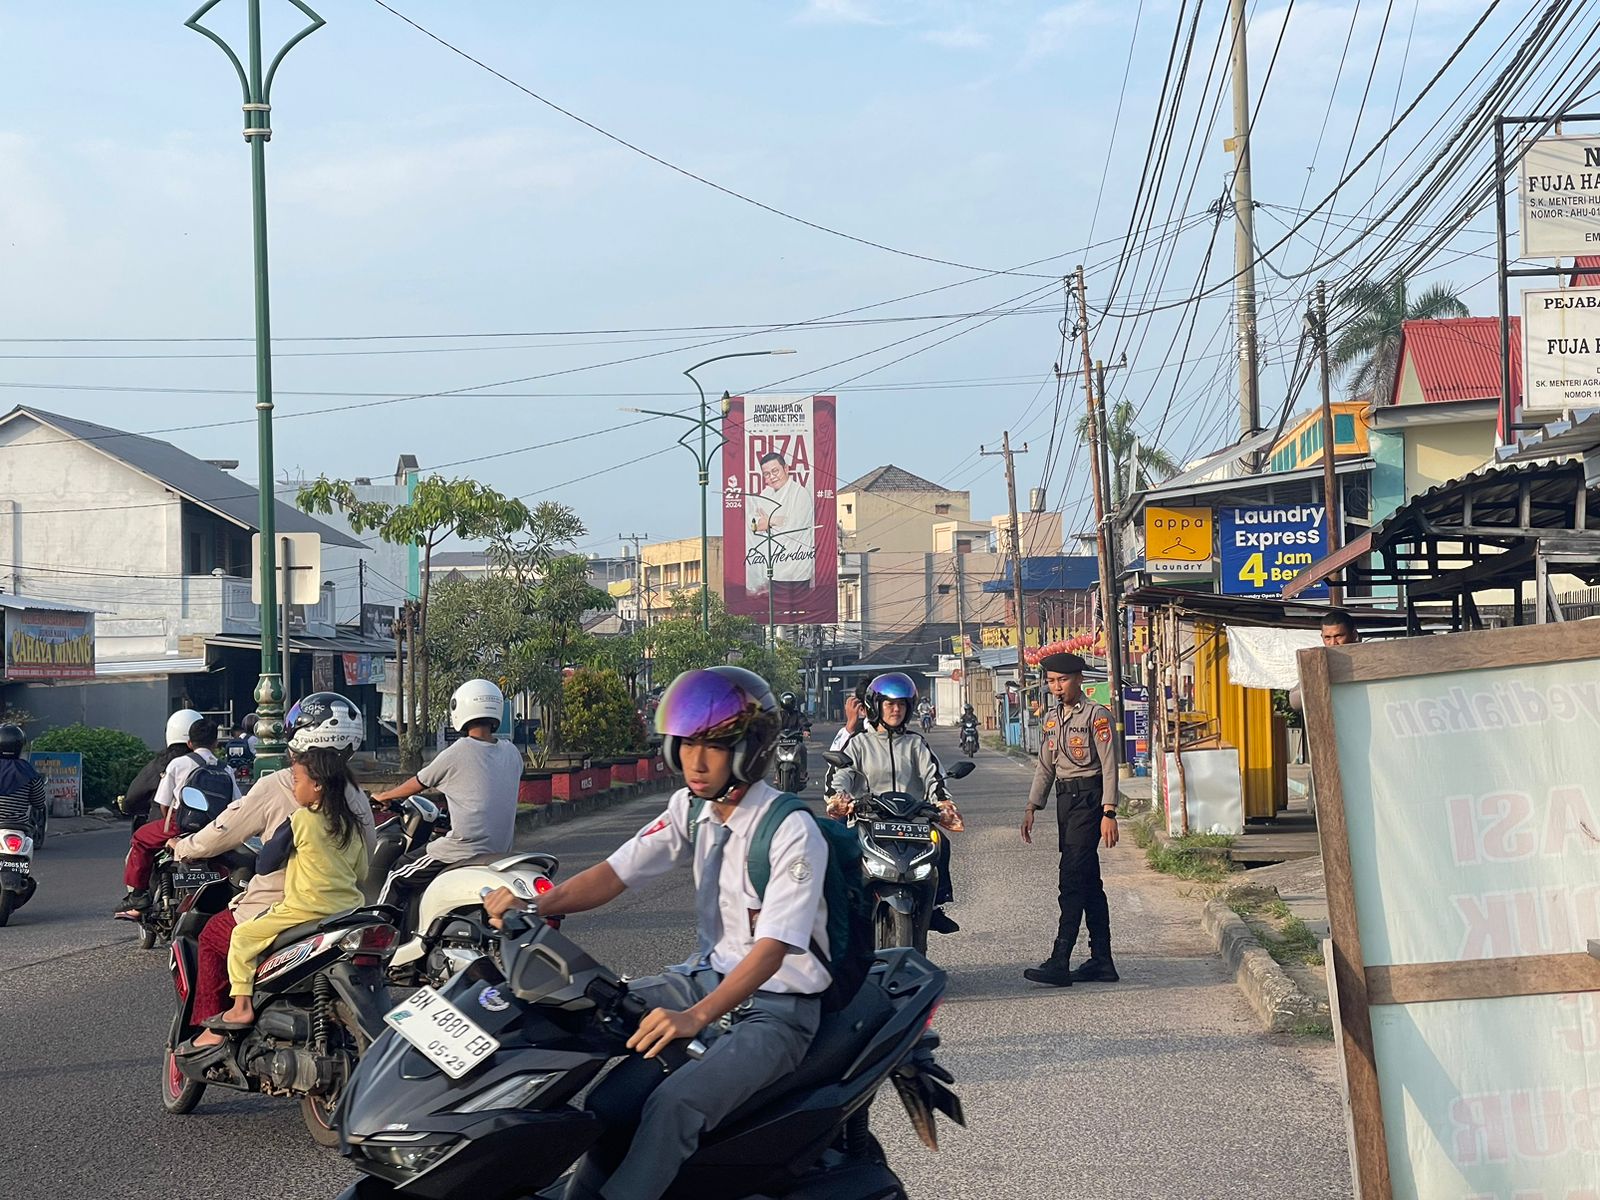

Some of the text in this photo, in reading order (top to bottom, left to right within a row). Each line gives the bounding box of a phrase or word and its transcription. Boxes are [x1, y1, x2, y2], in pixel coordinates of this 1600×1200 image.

[1528, 174, 1575, 192] FUJA
[1530, 198, 1546, 207] S.K.
[1549, 196, 1587, 206] MENTERI
[1531, 209, 1563, 219] NOMOR
[1547, 338, 1590, 355] FUJA
[1549, 379, 1581, 387] MENTERI
[1154, 518, 1203, 531] appa
[1234, 505, 1325, 528] Laundry
[1235, 529, 1320, 551] Express
[1274, 551, 1312, 565] Jam
[1238, 552, 1268, 588] 4
[12, 628, 91, 665] CAHAYA MINANG
[409, 989, 492, 1057] BN 4880 EB
